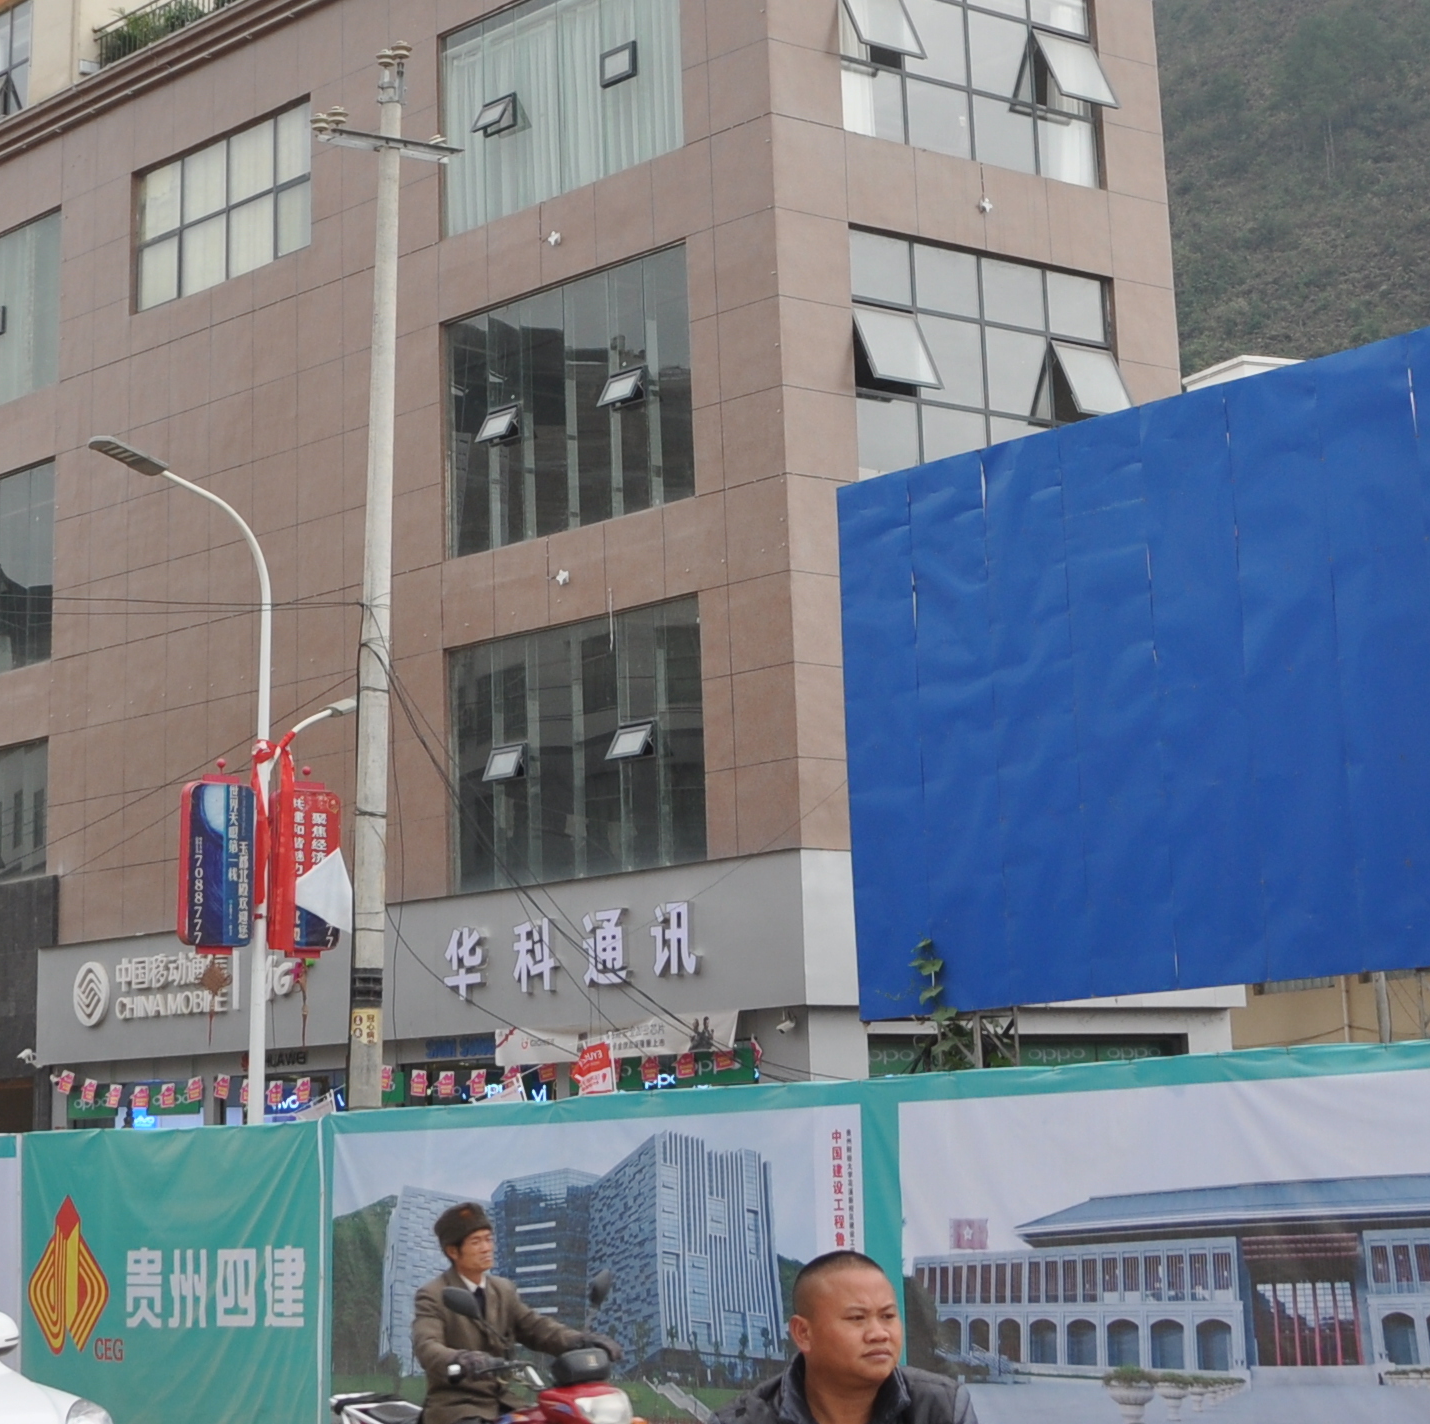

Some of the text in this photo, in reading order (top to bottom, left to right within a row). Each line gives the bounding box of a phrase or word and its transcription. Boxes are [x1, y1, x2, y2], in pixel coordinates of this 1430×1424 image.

[193, 854, 204, 944] 7088777
[444, 901, 699, 1000] 华科通讯
[115, 995, 167, 1020] CHINA
[125, 1245, 306, 1328] 贵州四建
[94, 1338, 123, 1362] CEG
